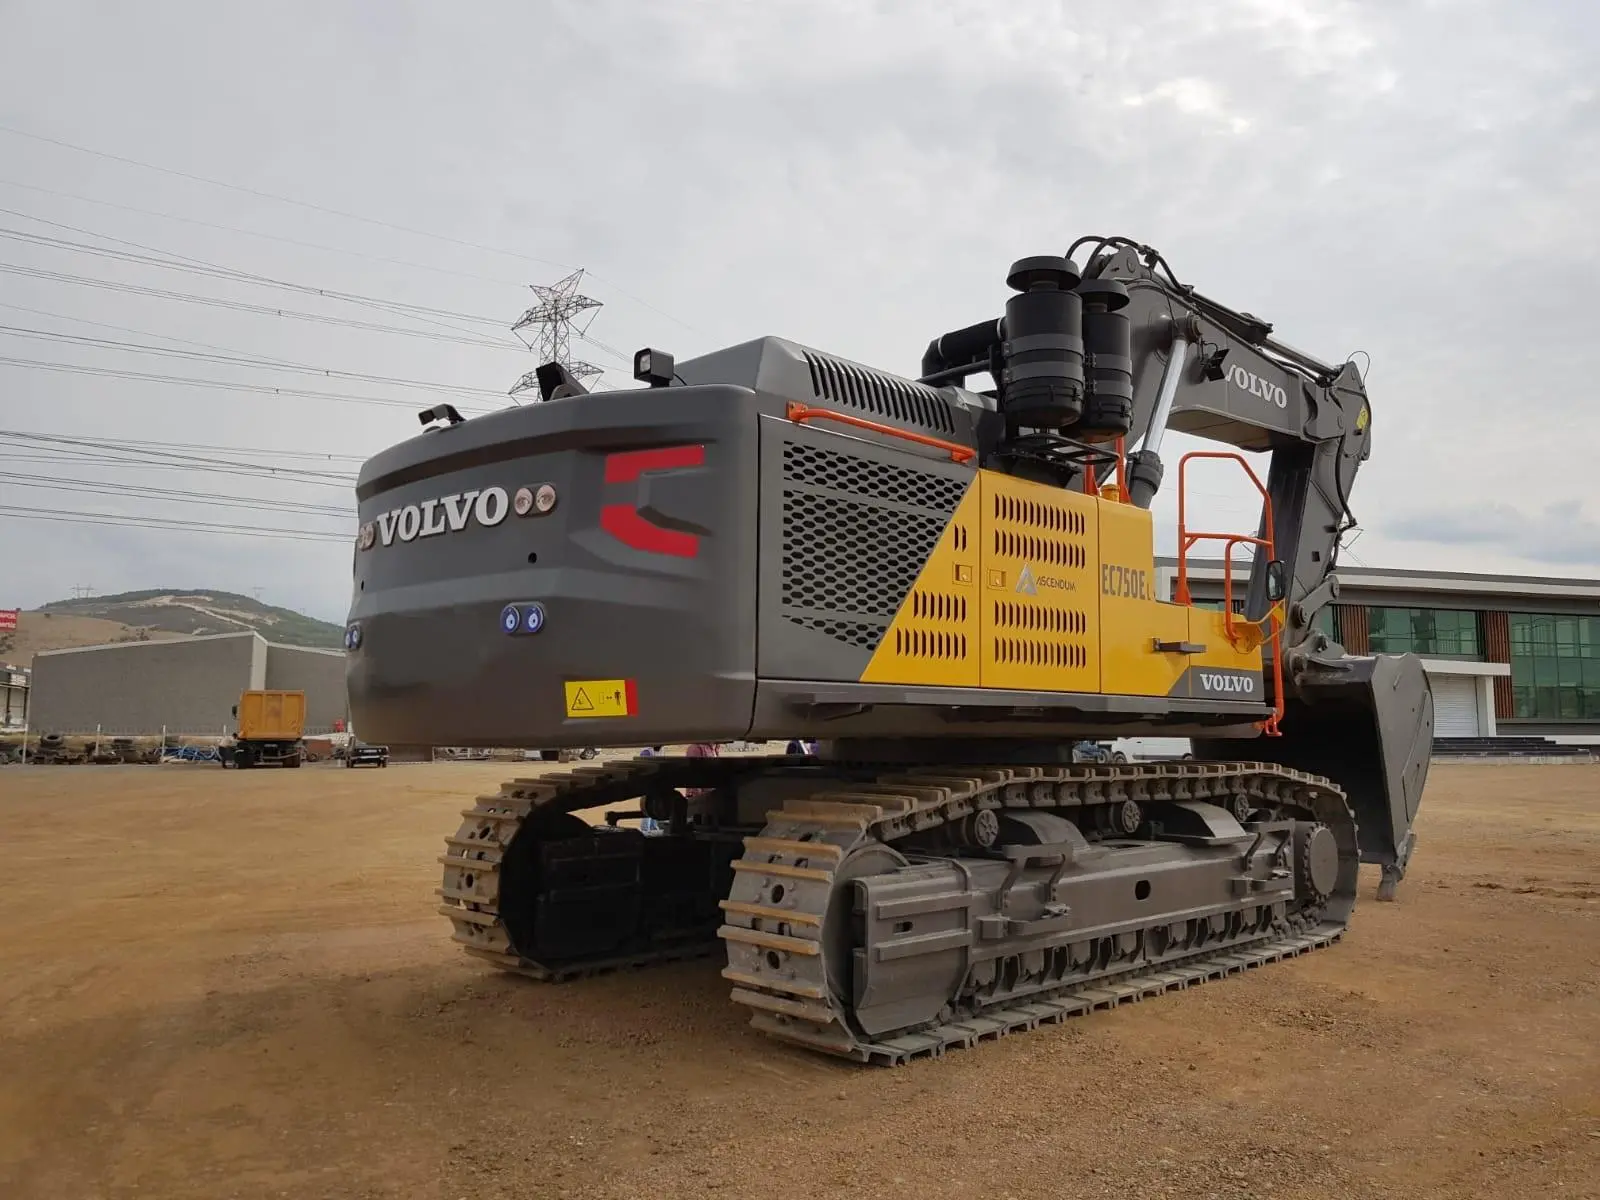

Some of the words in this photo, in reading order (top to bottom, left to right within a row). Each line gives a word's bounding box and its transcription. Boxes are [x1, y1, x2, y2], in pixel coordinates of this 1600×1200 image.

[376, 487, 508, 546] VOLVO
[1036, 575, 1077, 592] ASCENDUM
[1199, 673, 1253, 693] VOLVO
